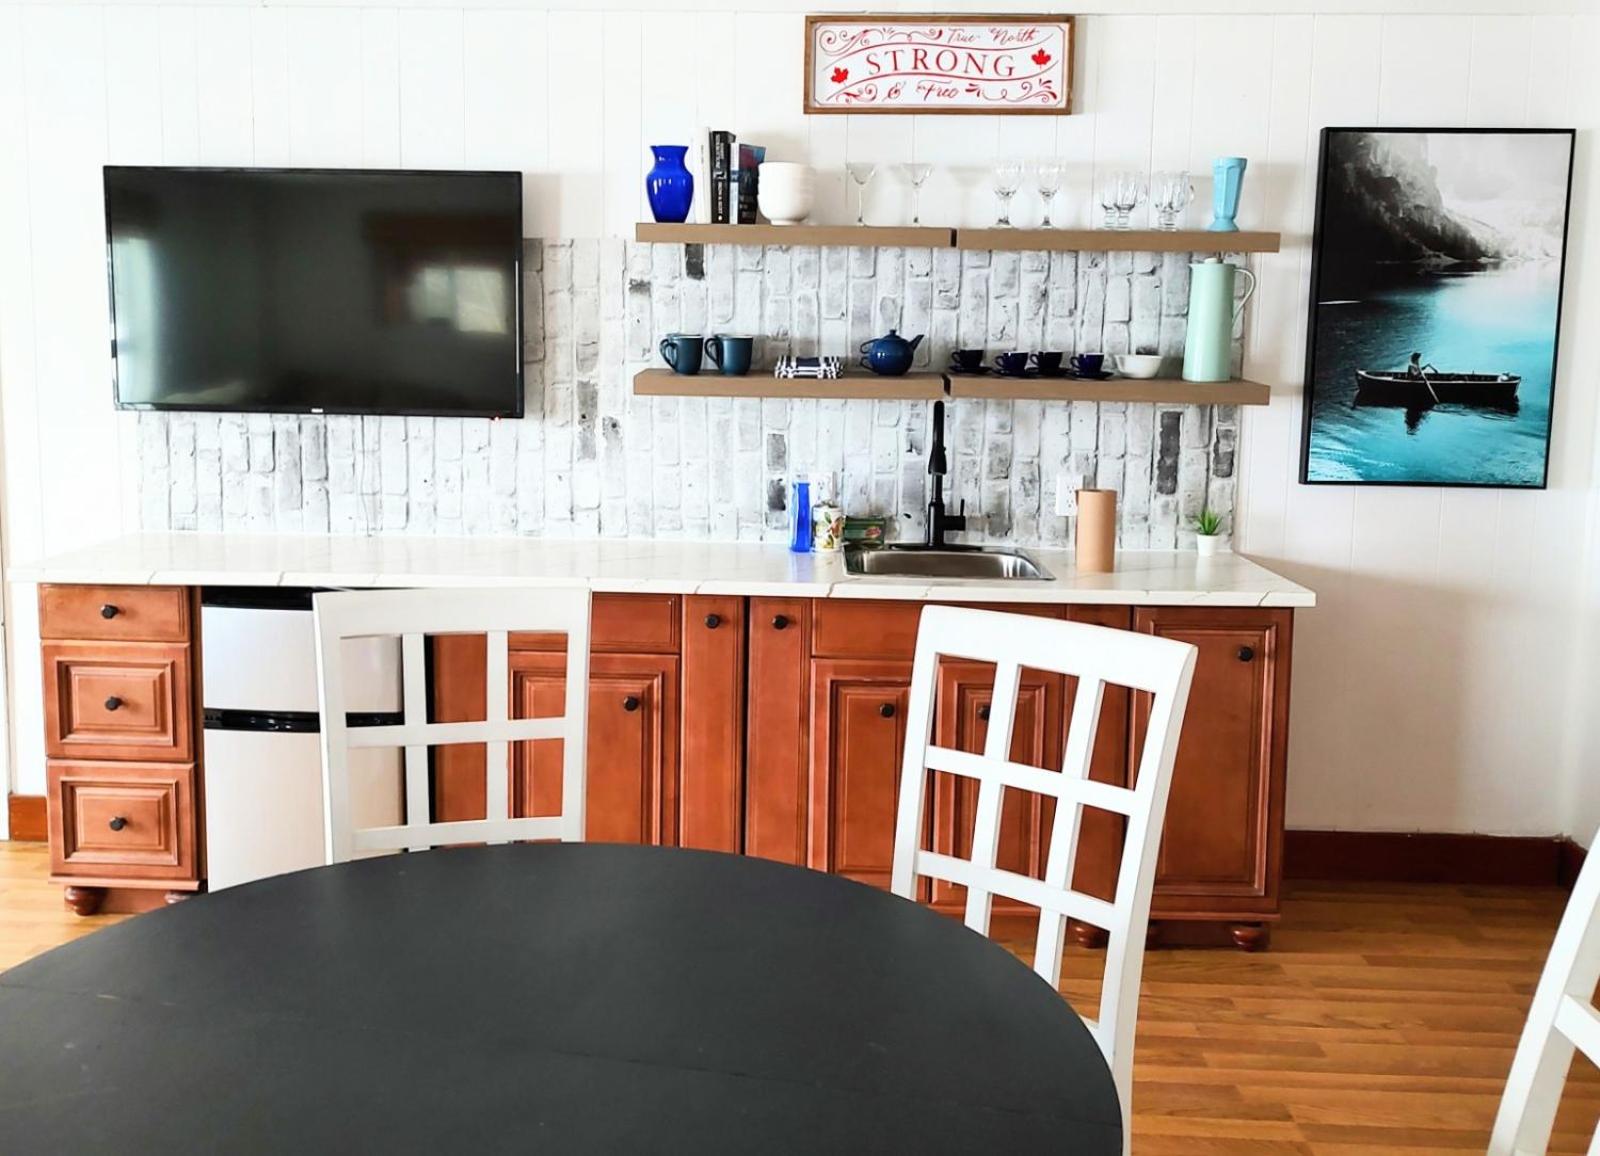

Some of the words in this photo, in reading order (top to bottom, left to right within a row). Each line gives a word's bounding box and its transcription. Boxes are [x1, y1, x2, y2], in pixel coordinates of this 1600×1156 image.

[947, 27, 977, 44] True
[988, 26, 1039, 46] North
[865, 48, 1016, 77] STRONG
[915, 79, 959, 101] Free
